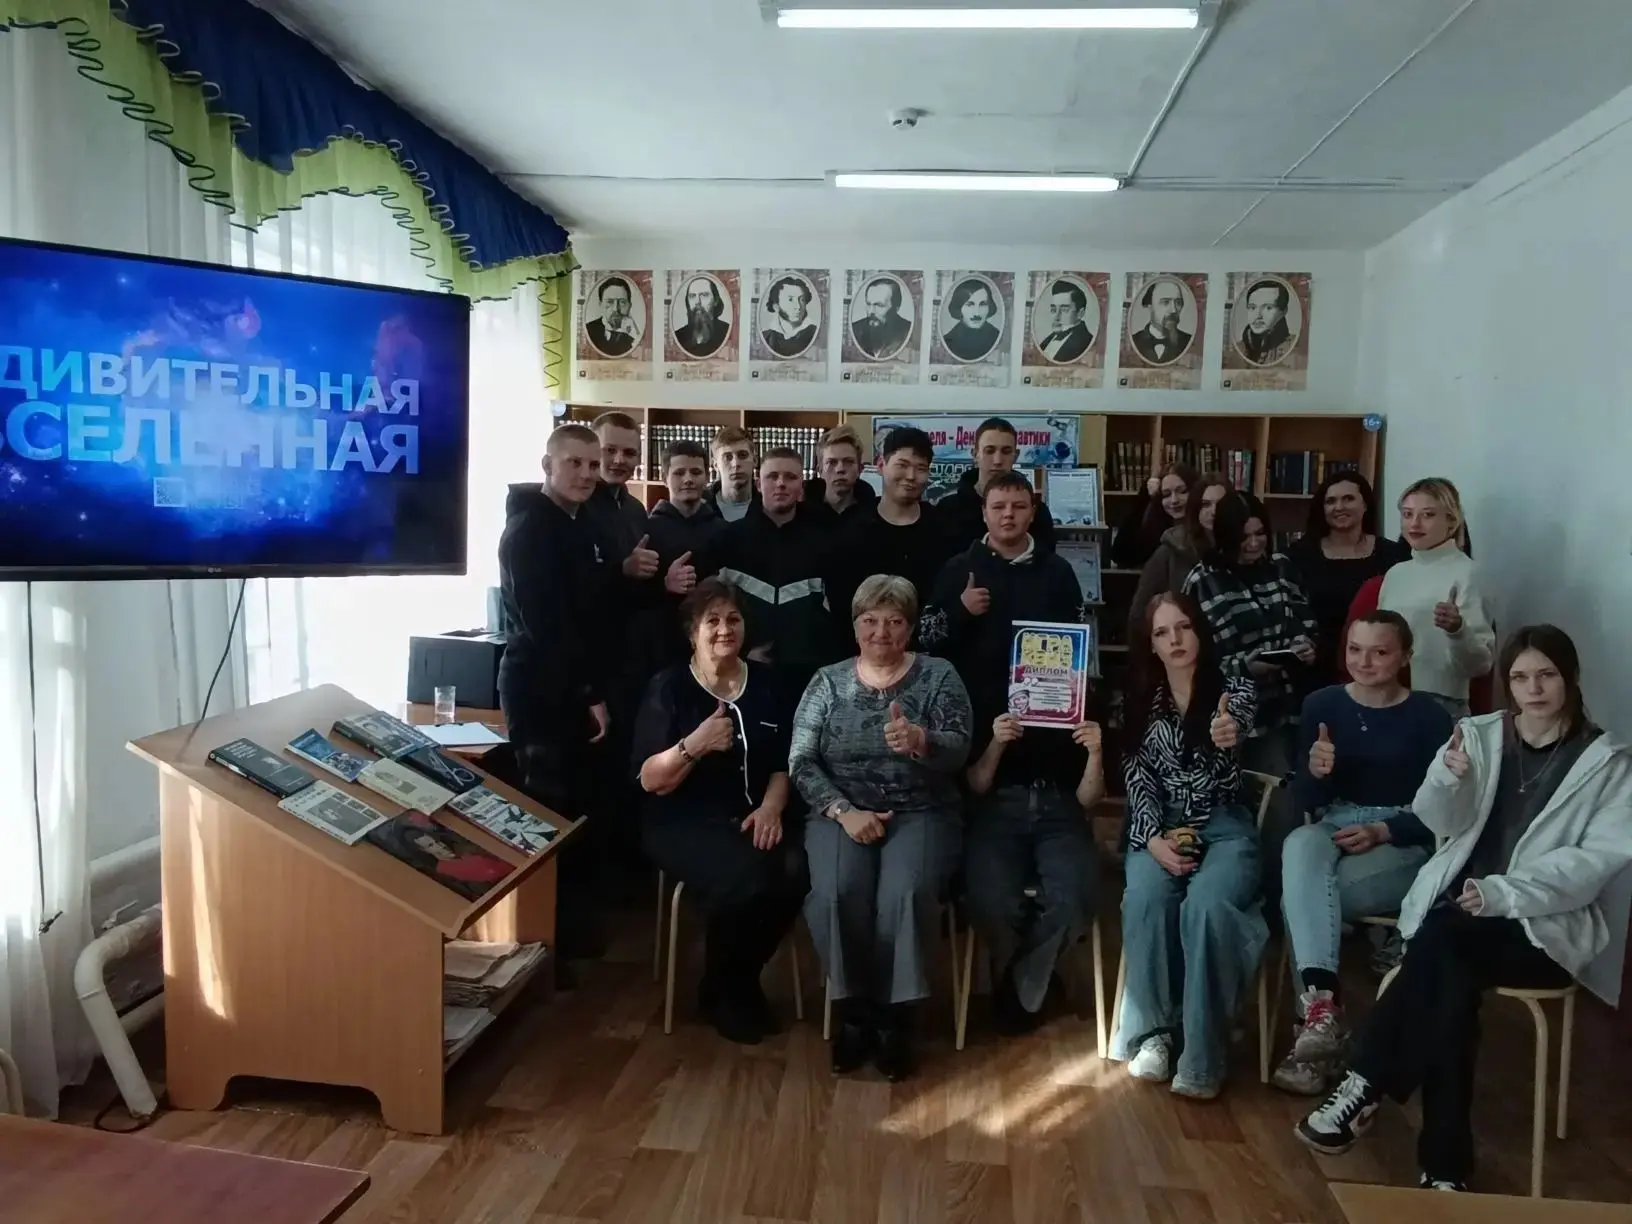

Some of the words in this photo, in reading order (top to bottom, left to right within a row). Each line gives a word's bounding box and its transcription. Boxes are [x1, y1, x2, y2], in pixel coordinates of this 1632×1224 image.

[0, 345, 419, 416] ДИВИТЕЛЬНАЯ
[0, 402, 419, 475] СЕЛЕННАЯ
[929, 431, 946, 446] еля
[956, 426, 976, 450] Ден
[1016, 431, 1051, 446] автики
[1025, 666, 1069, 676] ДИПЛОМ
